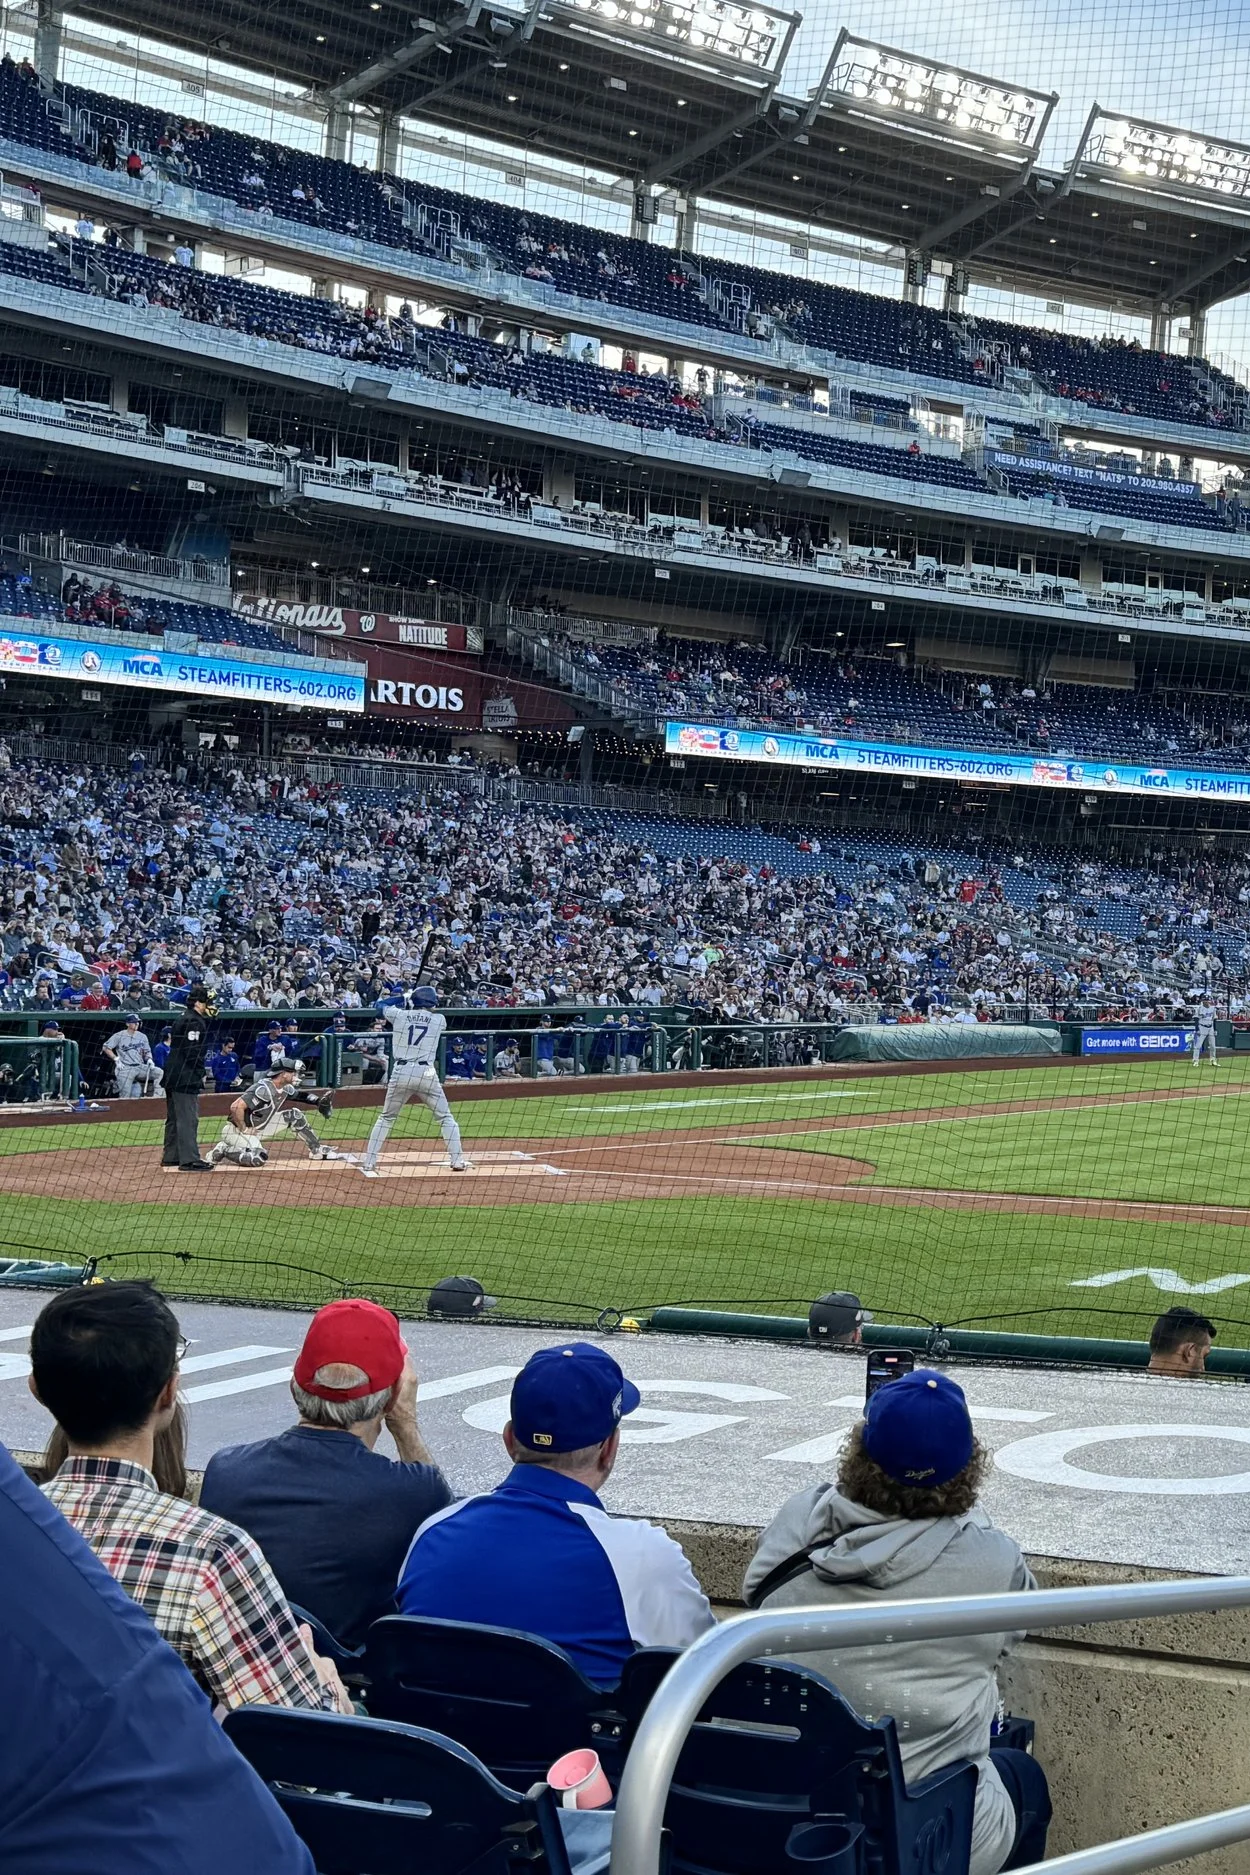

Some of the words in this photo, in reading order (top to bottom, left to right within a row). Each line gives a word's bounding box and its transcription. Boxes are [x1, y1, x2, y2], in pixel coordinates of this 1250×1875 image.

[994, 452, 1018, 465] NEED
[1018, 457, 1072, 475] ASSISTANCE?
[1073, 467, 1094, 479] TEXT
[1127, 475, 1139, 486] TO
[1140, 478, 1195, 494] 202.980.4357
[398, 626, 448, 645] NATITUDE
[122, 659, 164, 677] MCA
[178, 666, 356, 701] STEAMFITTERS-602.ORG
[371, 679, 464, 712] RTOIS
[805, 744, 840, 760] MCA
[857, 750, 1013, 776] STEAMFITTERS-602.ORG
[1140, 774, 1170, 788] MCA
[408, 1024, 428, 1046] 17
[1086, 1037, 1100, 1048] Get
[1101, 1039, 1120, 1048] more
[1121, 1036, 1137, 1047] with
[1140, 1035, 1180, 1048] GEICO
